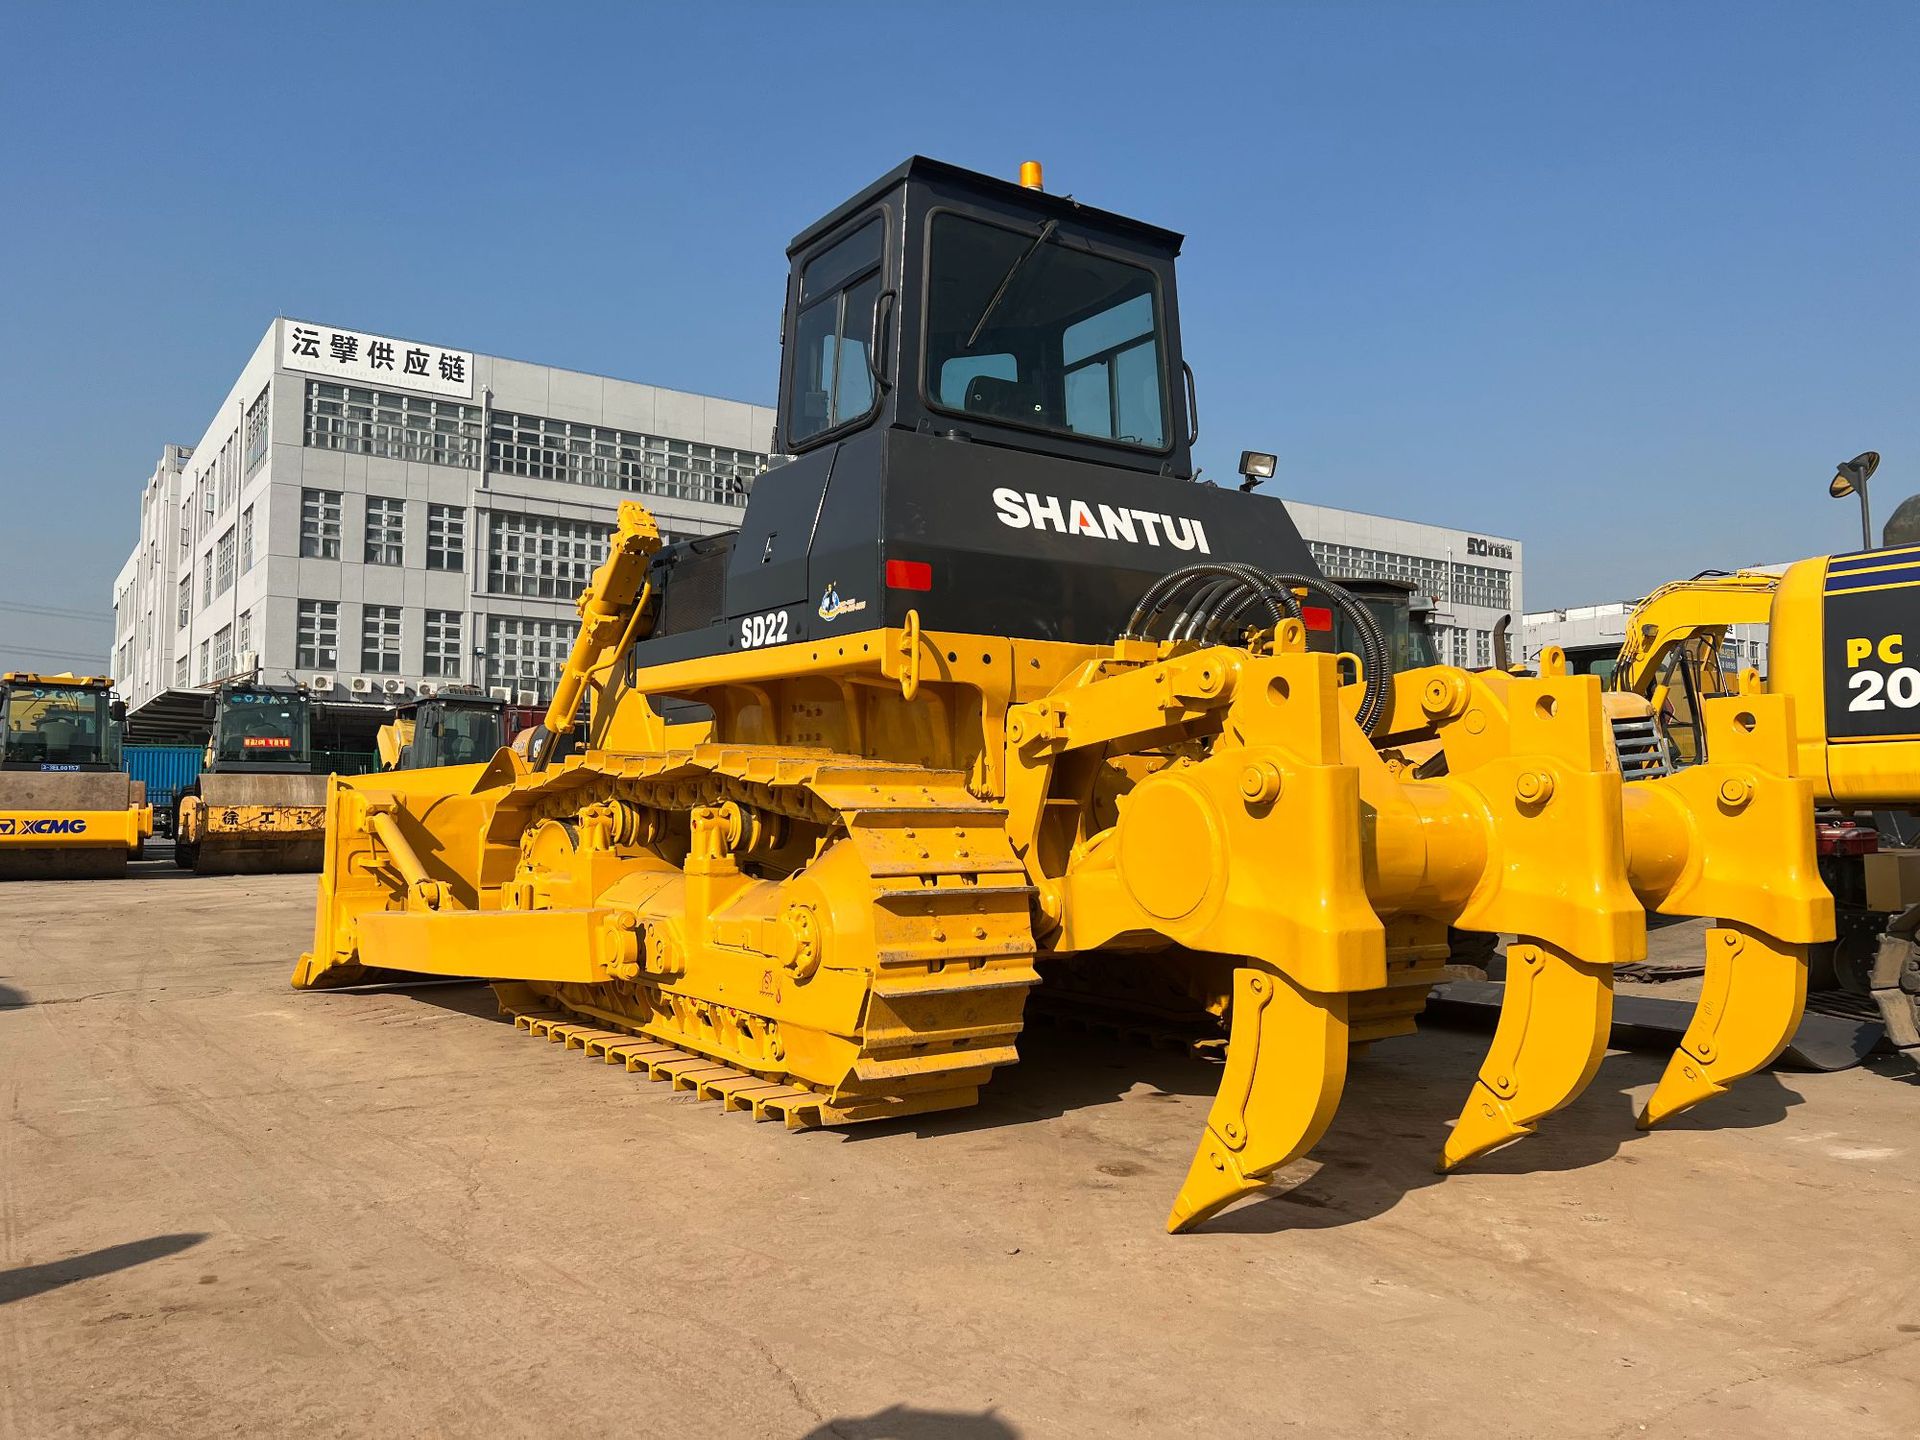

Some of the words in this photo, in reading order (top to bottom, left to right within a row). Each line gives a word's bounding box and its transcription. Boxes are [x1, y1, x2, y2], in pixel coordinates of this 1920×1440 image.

[292, 327, 465, 383] 沄擘供应链
[992, 487, 1211, 554] SHANTUI
[741, 610, 788, 649] SD22
[1847, 634, 1903, 668] PC
[17, 820, 87, 835] XCMG
